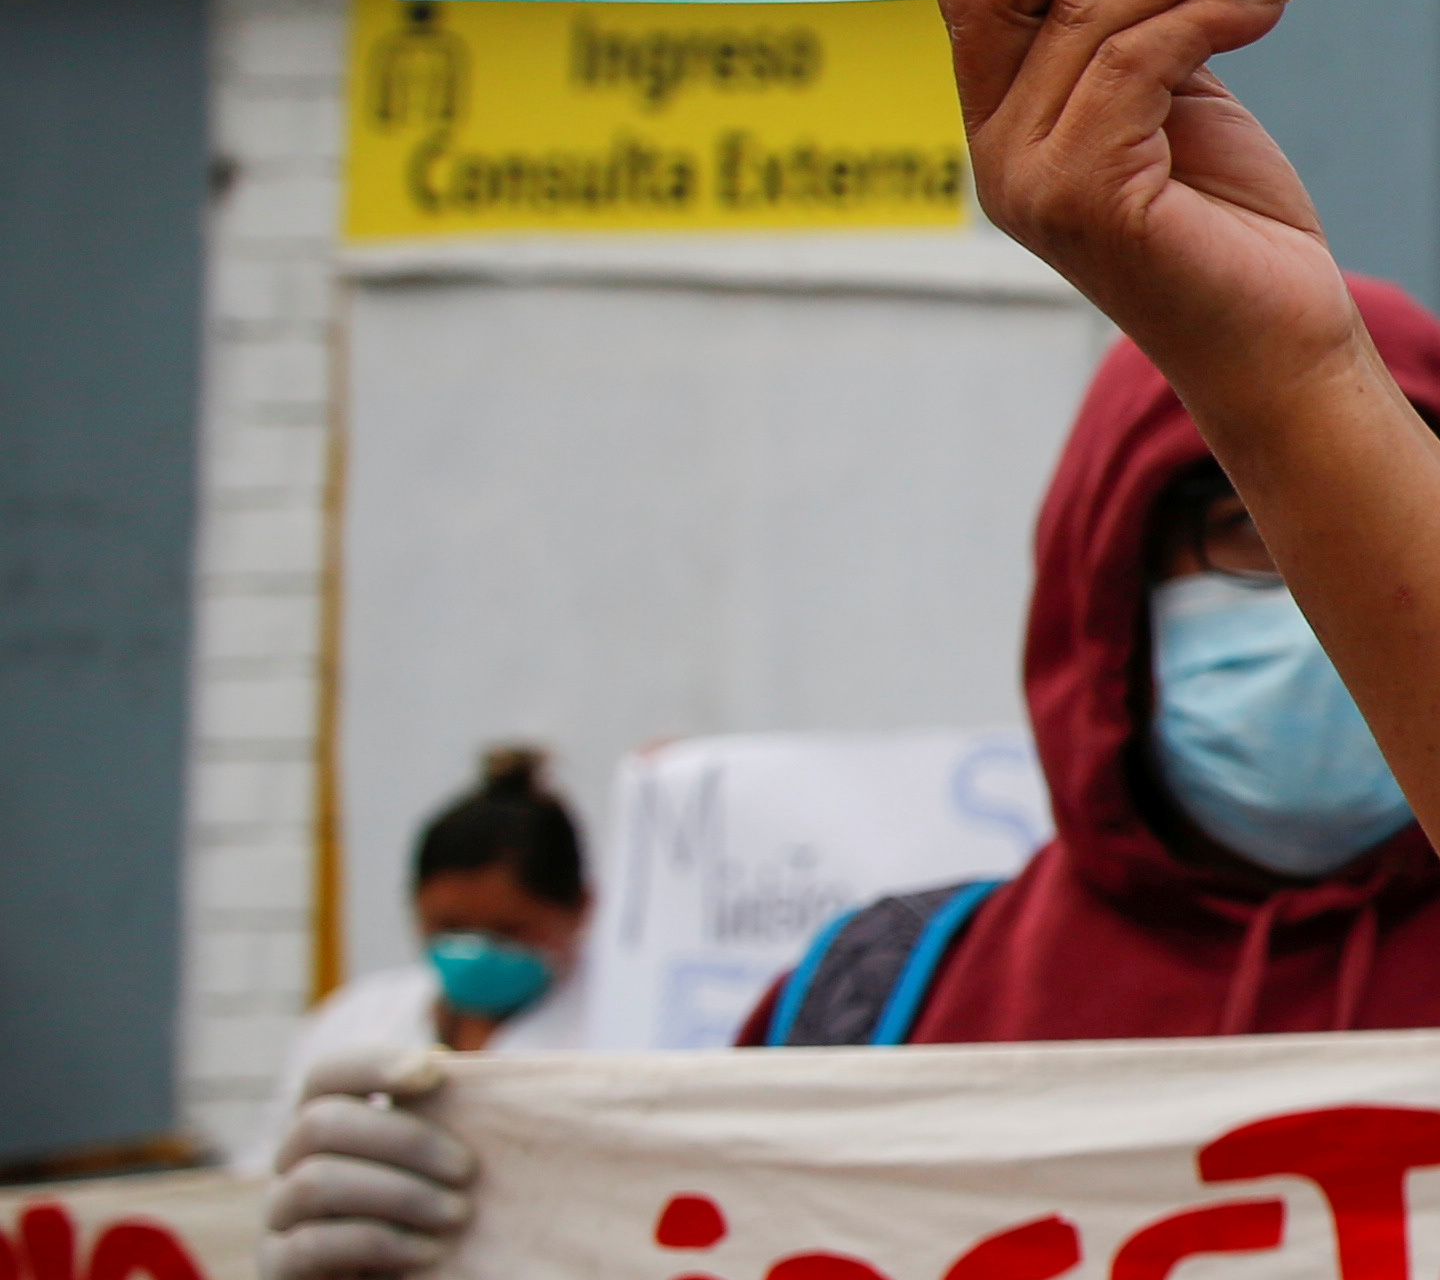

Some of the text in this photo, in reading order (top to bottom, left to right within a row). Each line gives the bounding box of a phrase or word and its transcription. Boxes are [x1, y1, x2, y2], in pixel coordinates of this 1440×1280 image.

[571, 20, 820, 110] Ingreso
[407, 130, 962, 214] Consulta Externa
